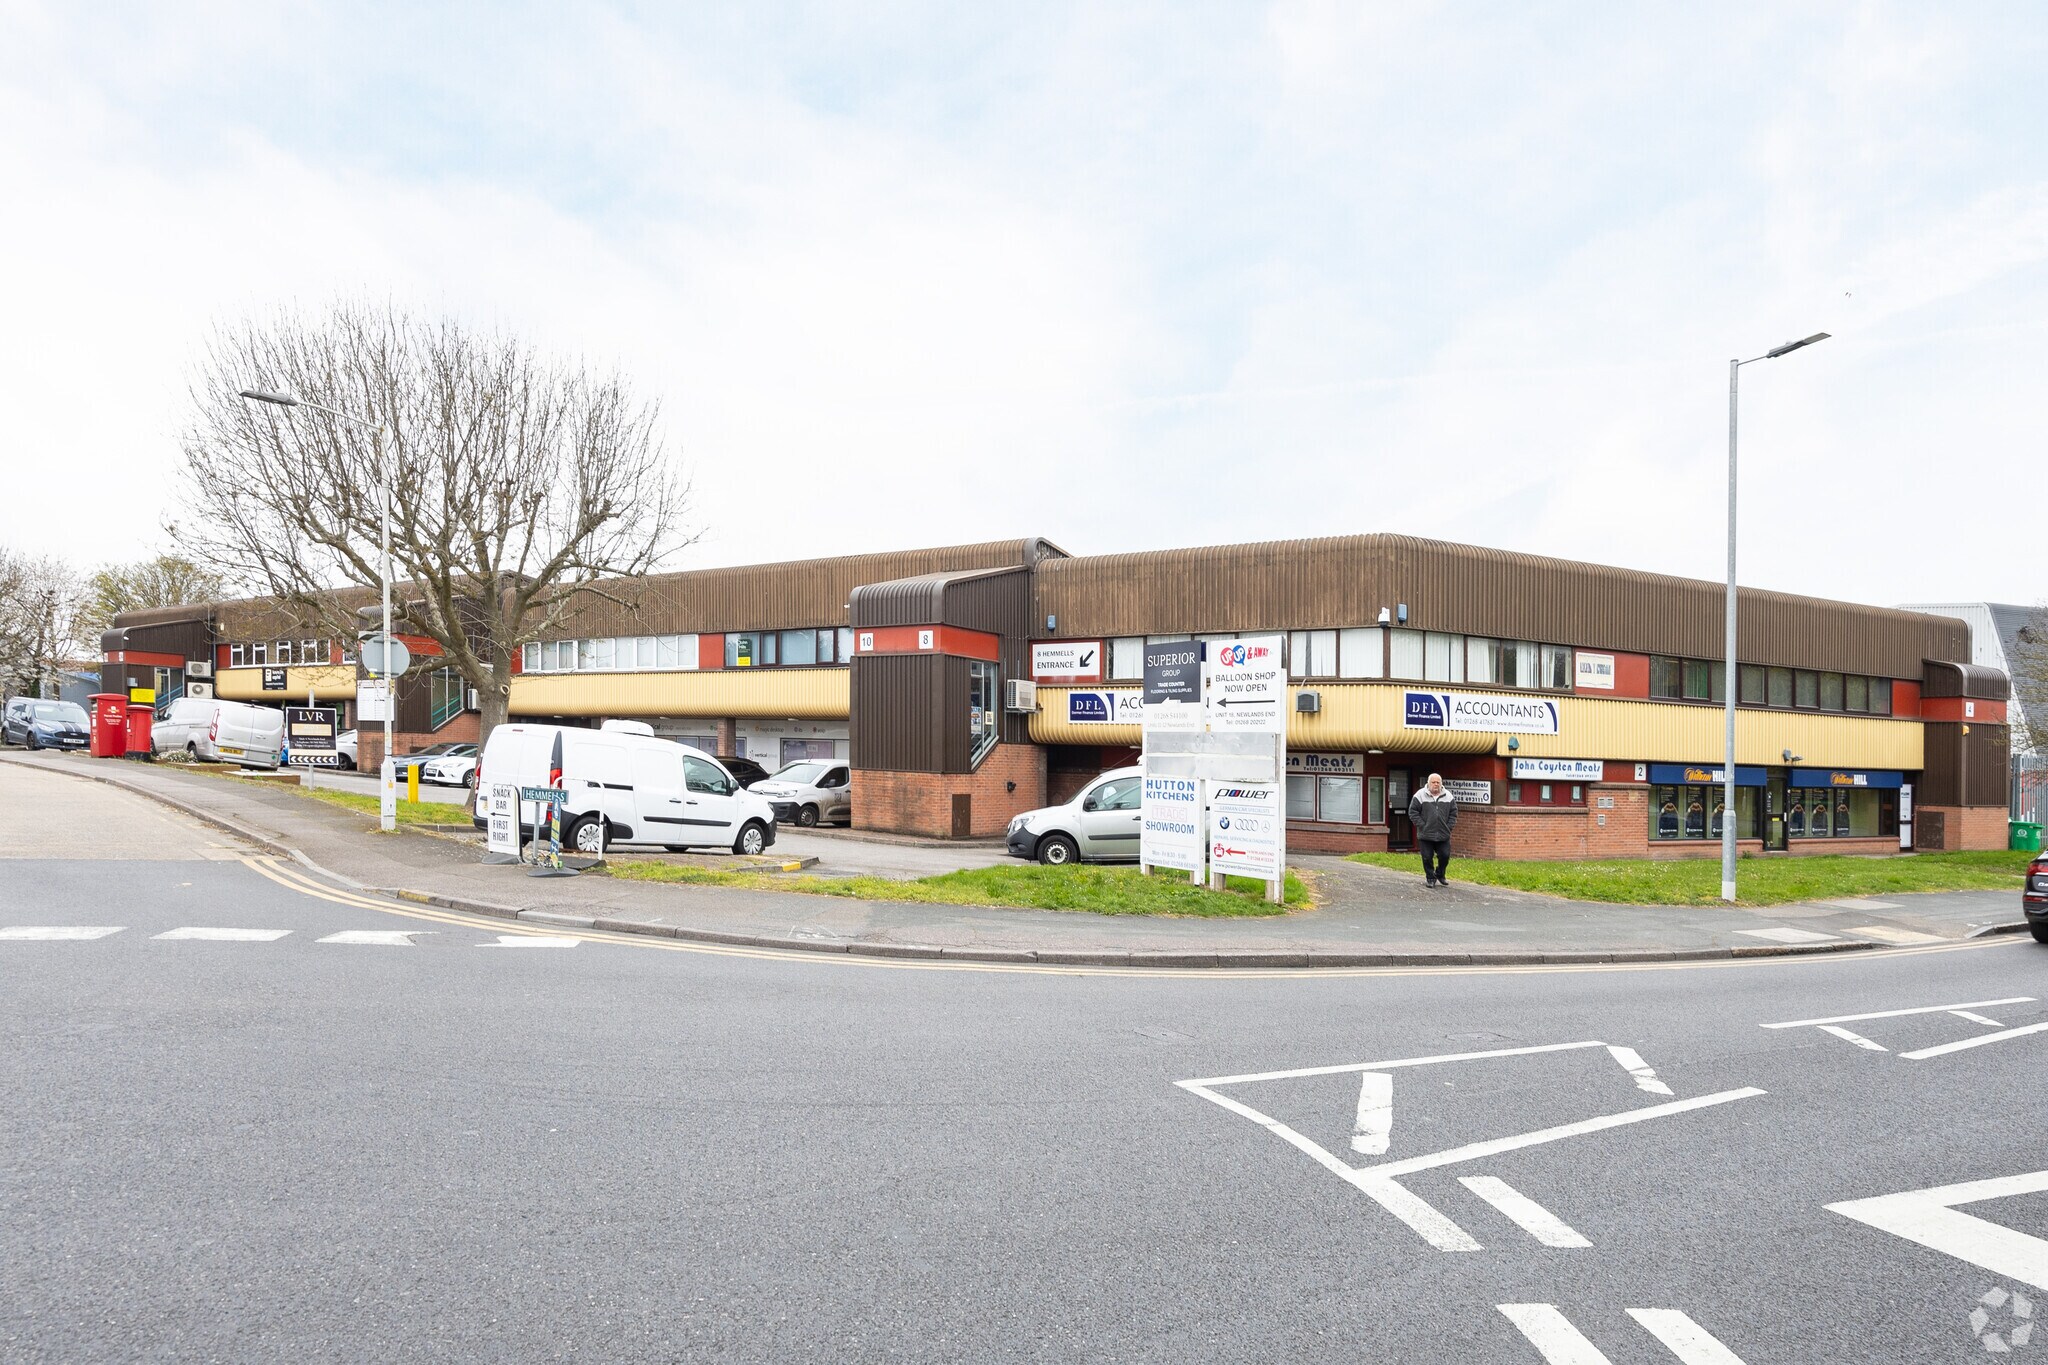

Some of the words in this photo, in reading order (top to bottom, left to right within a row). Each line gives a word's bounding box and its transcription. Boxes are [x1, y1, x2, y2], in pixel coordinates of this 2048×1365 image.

[862, 637, 872, 647] 10
[923, 635, 929, 645] 8
[1247, 647, 1253, 660] &
[1254, 647, 1269, 658] AWAY
[1147, 652, 1196, 667] SUPERIOR
[1037, 661, 1074, 669] ENTRANCE
[1162, 669, 1180, 677] GROUP
[1216, 673, 1253, 682] BALLOON
[1255, 672, 1276, 680] SHOP
[1225, 685, 1243, 693] NOW
[1246, 684, 1267, 692] OPEN
[1455, 701, 1544, 719] ACCOUNTANTS
[299, 711, 325, 721] LVR
[1306, 754, 1354, 767] Meats
[1515, 760, 1534, 770] John
[1575, 762, 1600, 772] Meats
[1638, 767, 1643, 776] 2
[1712, 770, 1725, 782] HIL
[1854, 774, 1868, 785] HILL
[1146, 780, 1195, 791] HUTTON
[493, 788, 511, 798] SNACK
[1146, 791, 1195, 801] KITCHENS
[496, 800, 507, 810] BAR
[493, 820, 508, 830] FIRST
[1145, 820, 1195, 835] SHOWROOM
[493, 832, 509, 842] RIGHT
